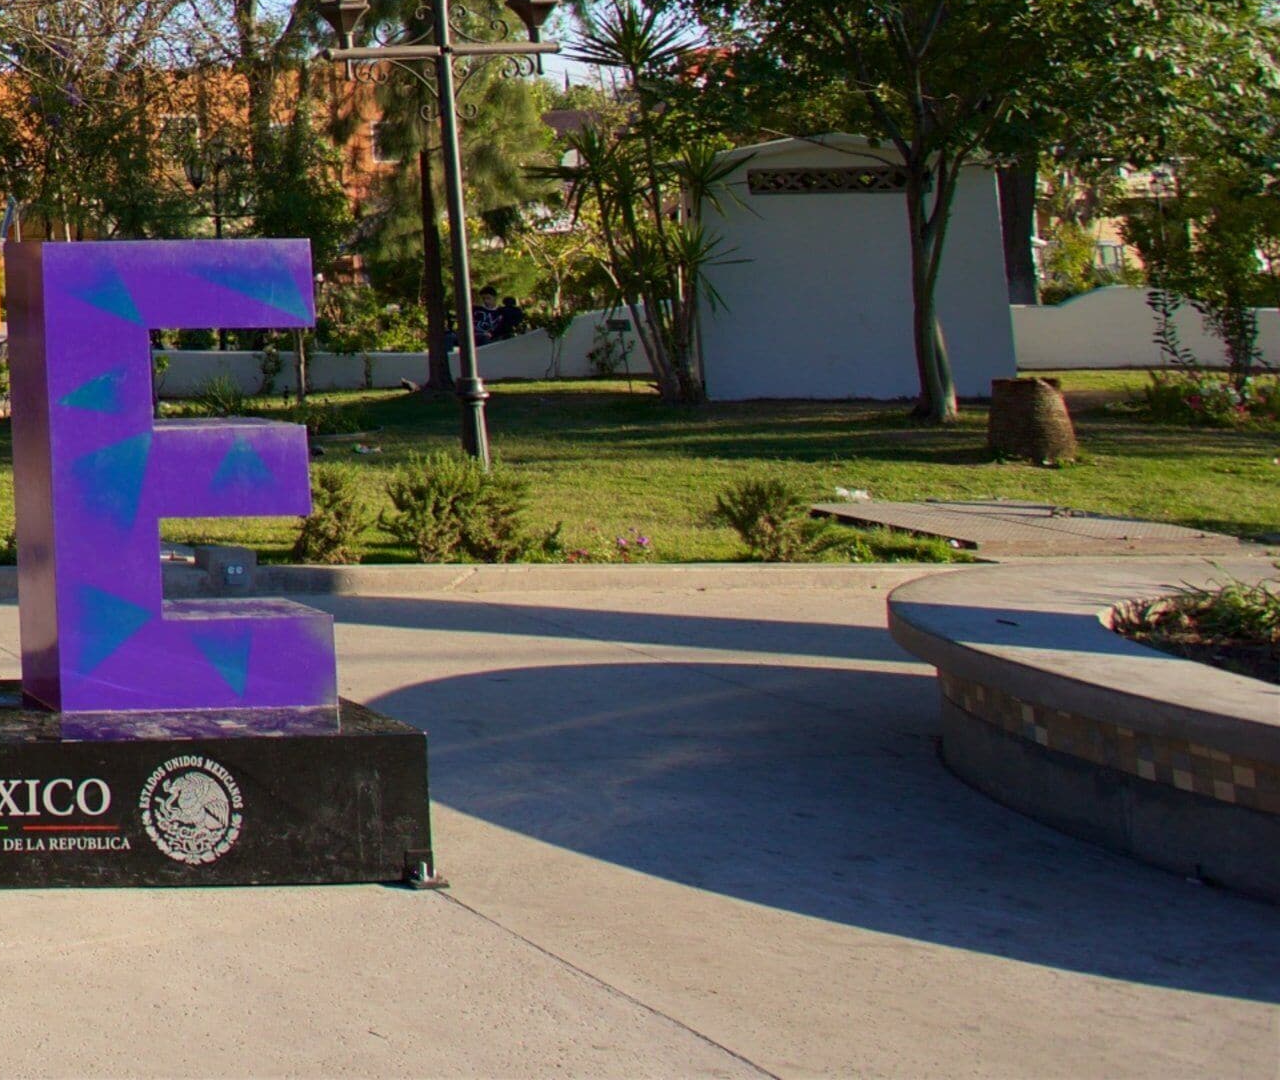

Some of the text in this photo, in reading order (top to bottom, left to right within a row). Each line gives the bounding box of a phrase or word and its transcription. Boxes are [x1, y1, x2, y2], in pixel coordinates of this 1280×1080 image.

[139, 766, 166, 809] ESTADOS
[164, 755, 203, 772] UNIDOS
[3, 838, 24, 851] DE
[27, 838, 44, 851] LA
